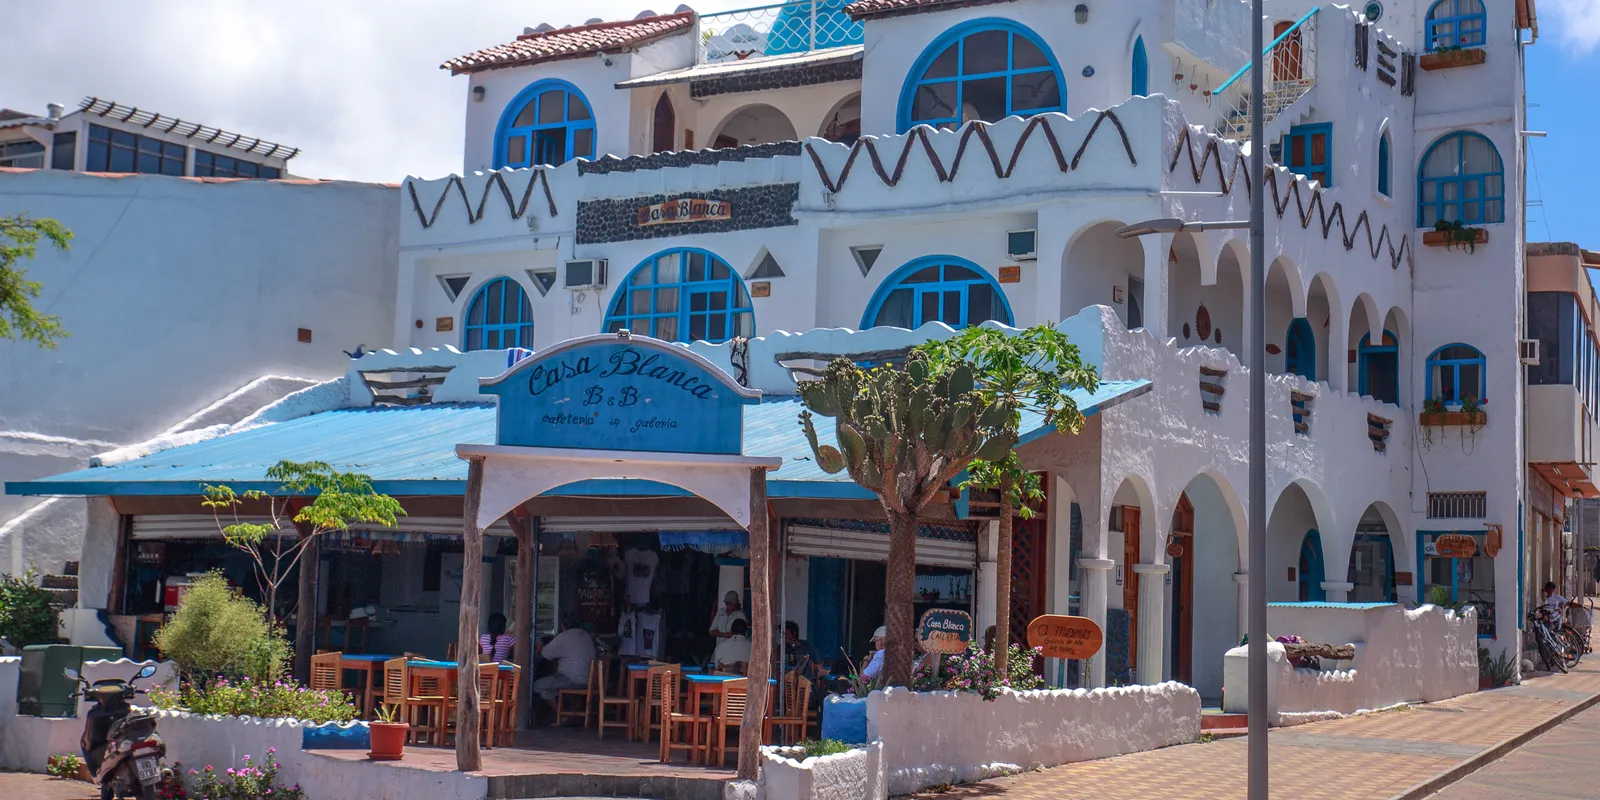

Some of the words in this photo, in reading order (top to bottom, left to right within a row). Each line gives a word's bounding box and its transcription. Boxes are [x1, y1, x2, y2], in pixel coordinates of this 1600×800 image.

[641, 205, 675, 222] Casa
[677, 200, 726, 218] Blanca
[528, 356, 599, 396] Casa
[600, 348, 713, 400] Blanca
[583, 384, 604, 407] B
[618, 385, 638, 407] B
[926, 617, 942, 629] Casa
[942, 618, 965, 631] Blanca
[1054, 625, 1093, 640] mano
